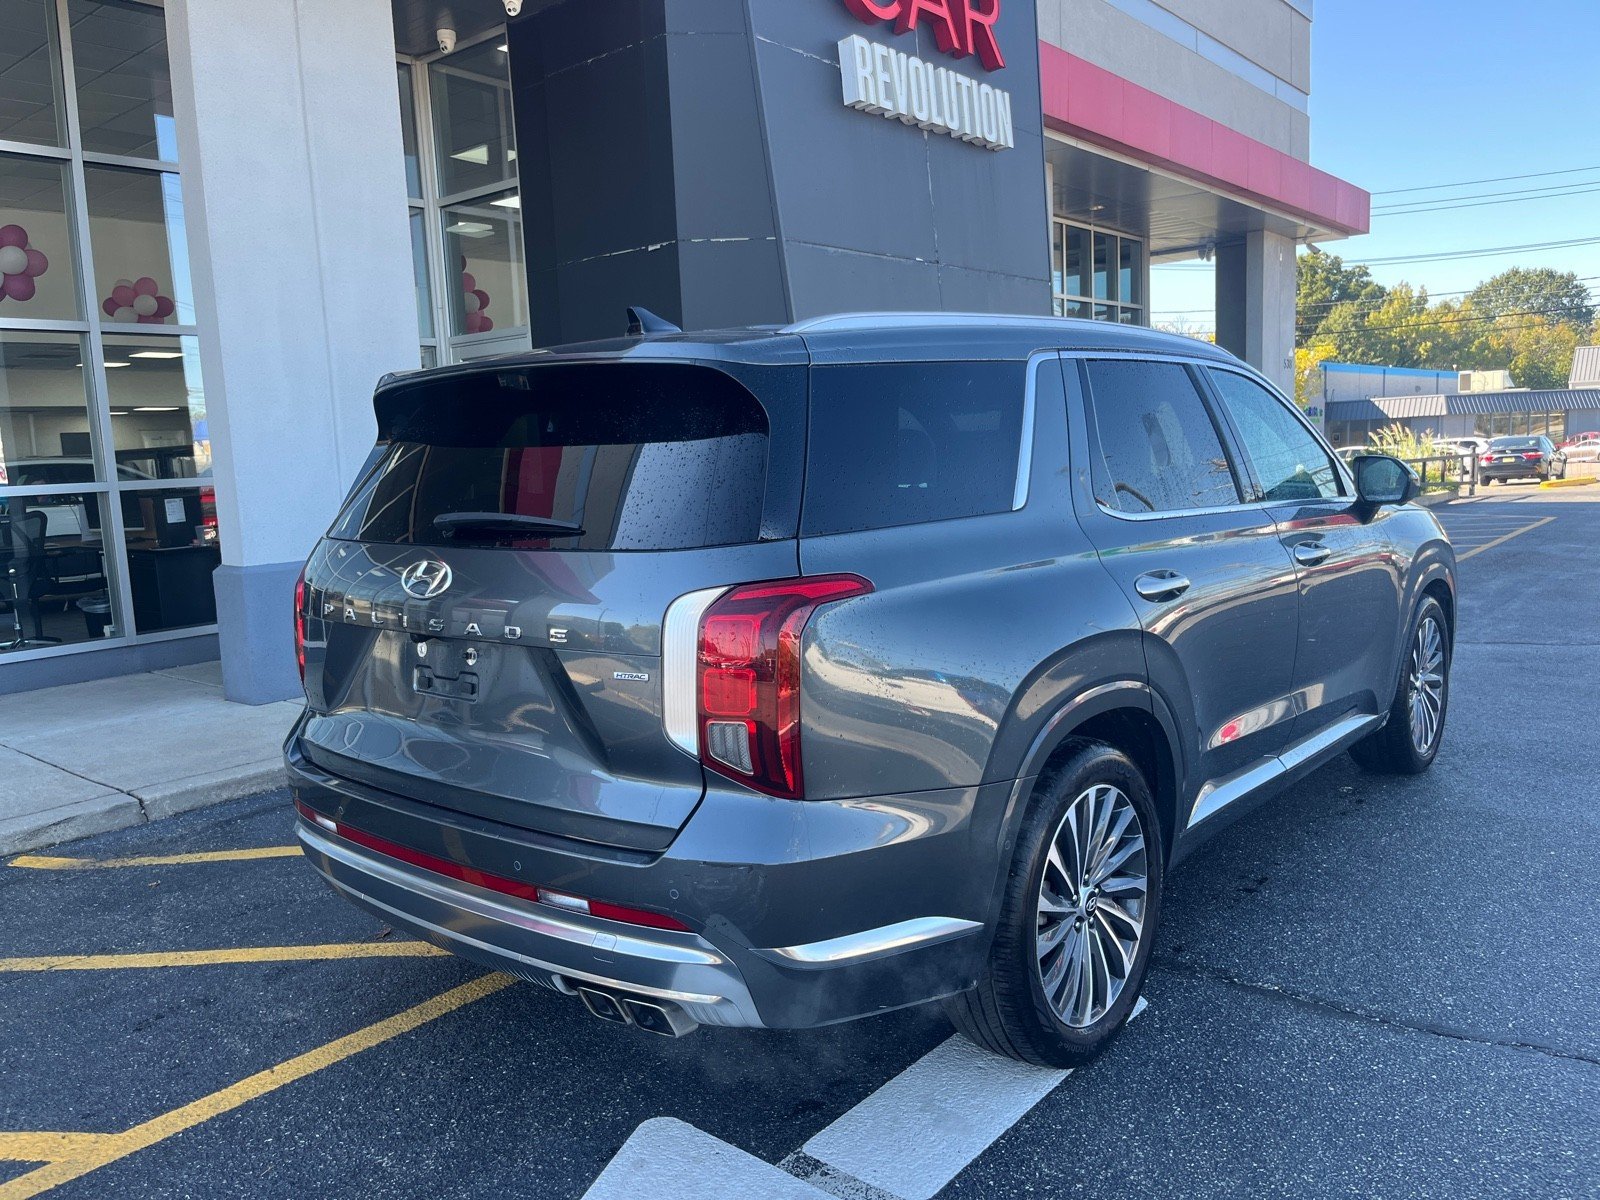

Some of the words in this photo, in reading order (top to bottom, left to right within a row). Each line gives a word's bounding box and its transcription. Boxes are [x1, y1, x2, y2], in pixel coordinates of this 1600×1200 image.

[845, 0, 1006, 71] AR
[838, 34, 1014, 150] REVOLUTION
[323, 603, 569, 643] PALISADE
[615, 672, 647, 680] HTRAC
